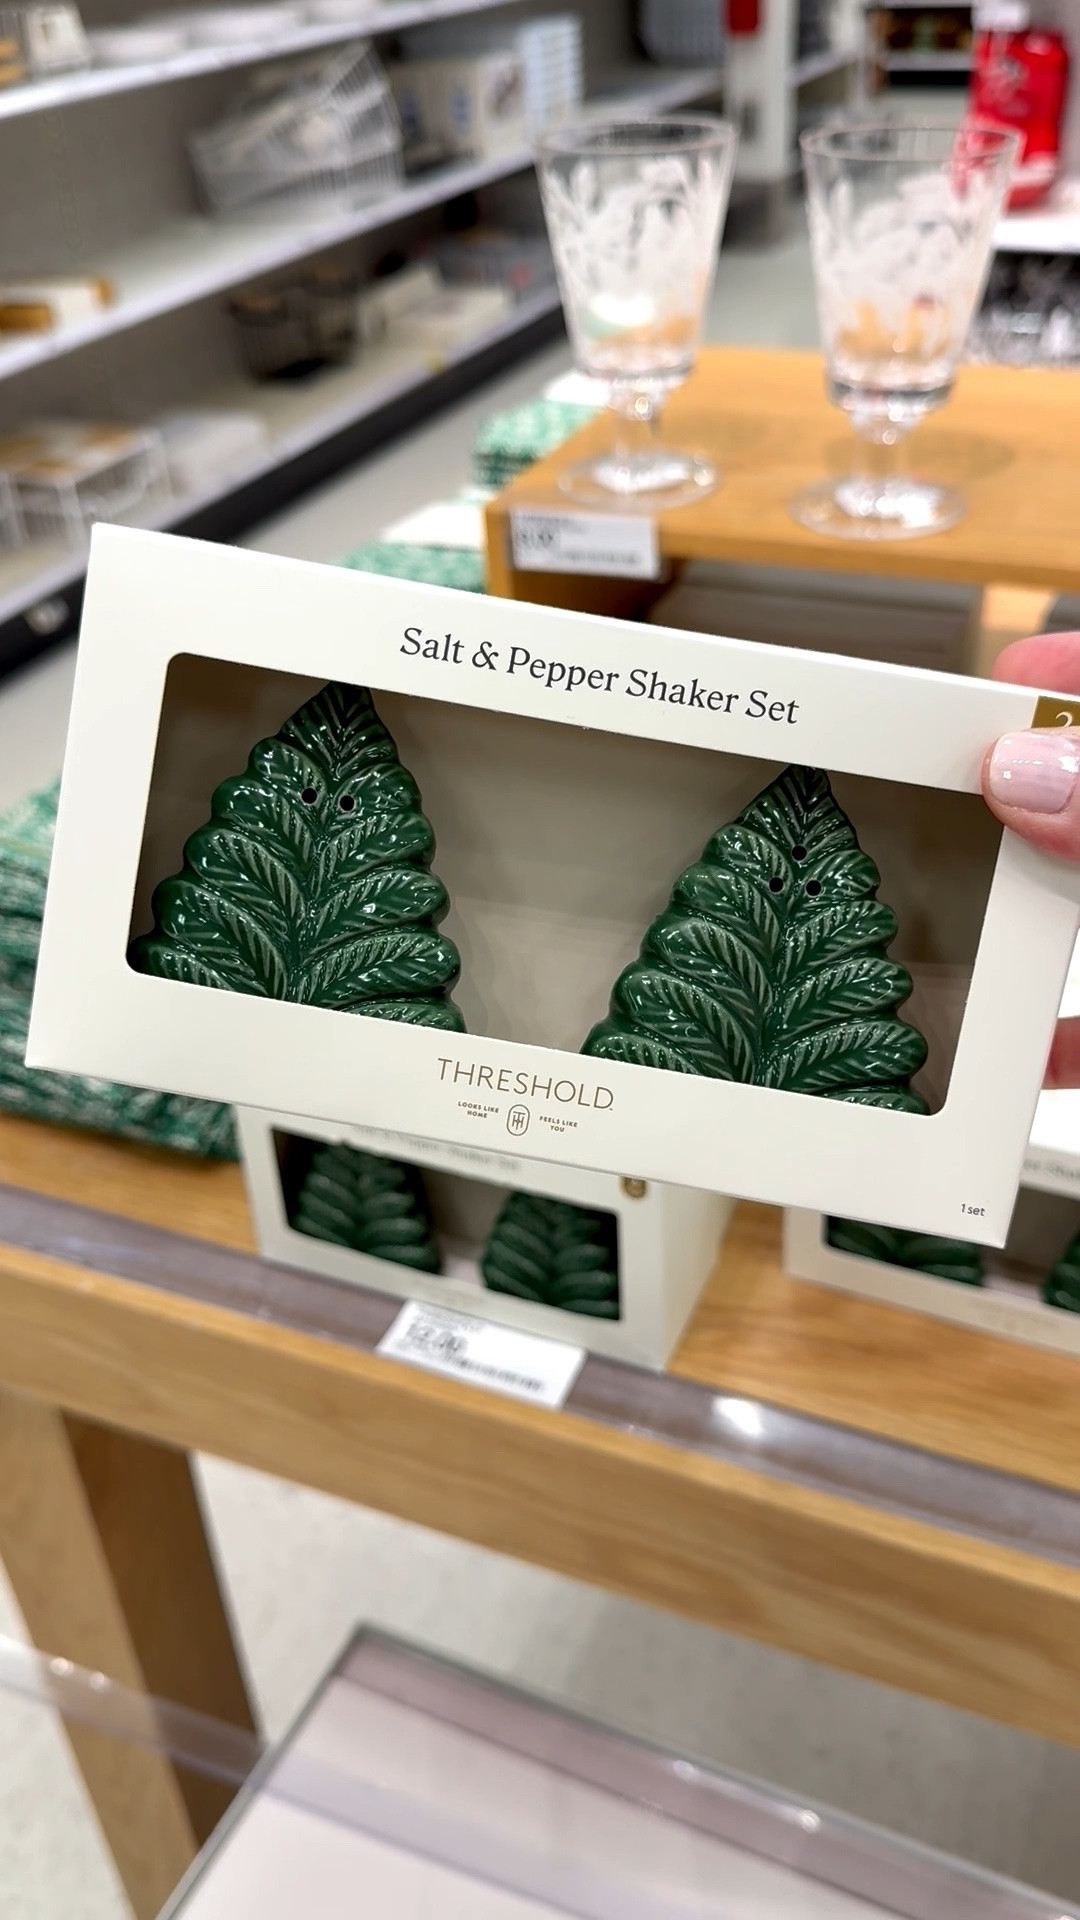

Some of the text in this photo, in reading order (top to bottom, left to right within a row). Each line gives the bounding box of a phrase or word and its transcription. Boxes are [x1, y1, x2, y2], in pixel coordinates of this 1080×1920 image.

[400, 627, 800, 724] Salt & Pepper Shaker Set
[438, 1058, 614, 1110] THRESHOLD
[458, 1101, 499, 1113] LOOKS LIKE
[467, 1110, 488, 1118] HOME
[539, 1115, 578, 1127] FEELS LIKE
[550, 1125, 565, 1133] YOU
